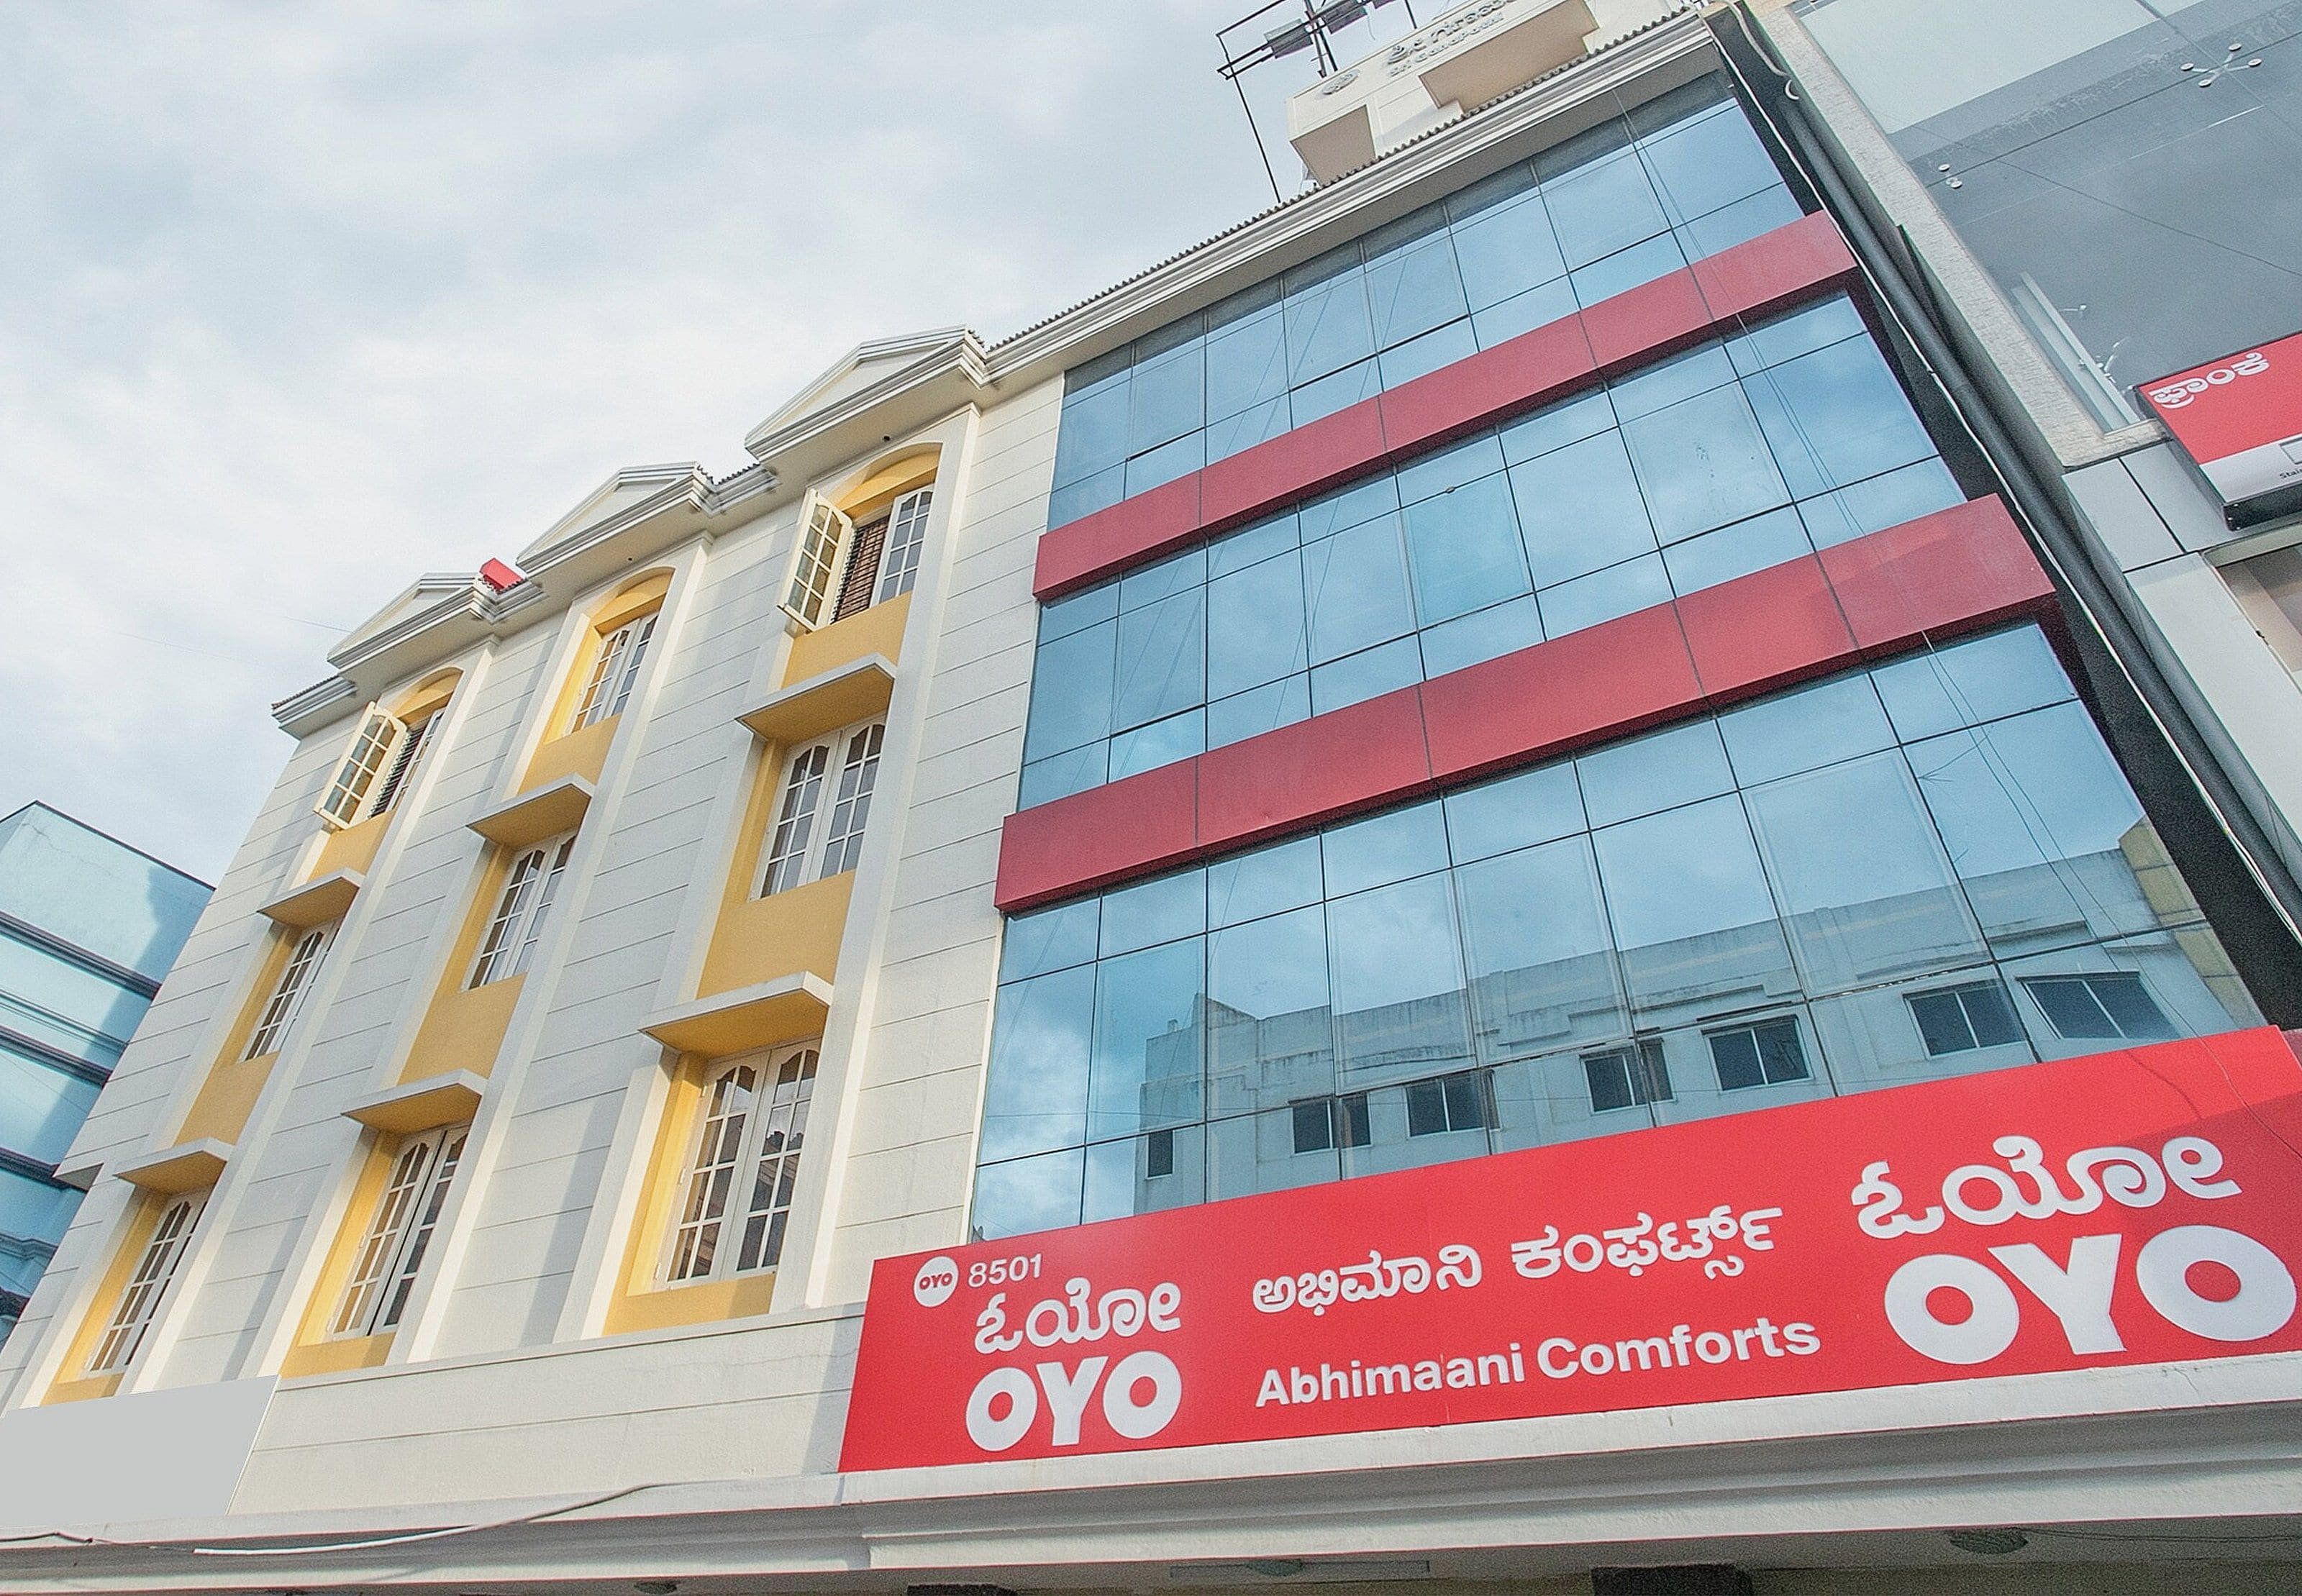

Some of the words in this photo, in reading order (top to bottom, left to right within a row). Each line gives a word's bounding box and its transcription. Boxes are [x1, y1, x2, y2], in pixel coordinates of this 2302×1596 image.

[1851, 1135, 2242, 1239] ಓಯೋ
[919, 1272, 953, 1290] OYO
[968, 1254, 1042, 1287] 8501
[974, 1277, 1181, 1354] ಓಯೋ
[1252, 1244, 1482, 1316] ಅಭಿಮಾನಿ
[1885, 1225, 2297, 1364] OYO
[965, 1351, 1182, 1451] OYO
[1255, 1342, 1524, 1408] Abhimaani
[1537, 1318, 1821, 1379] Comforts
